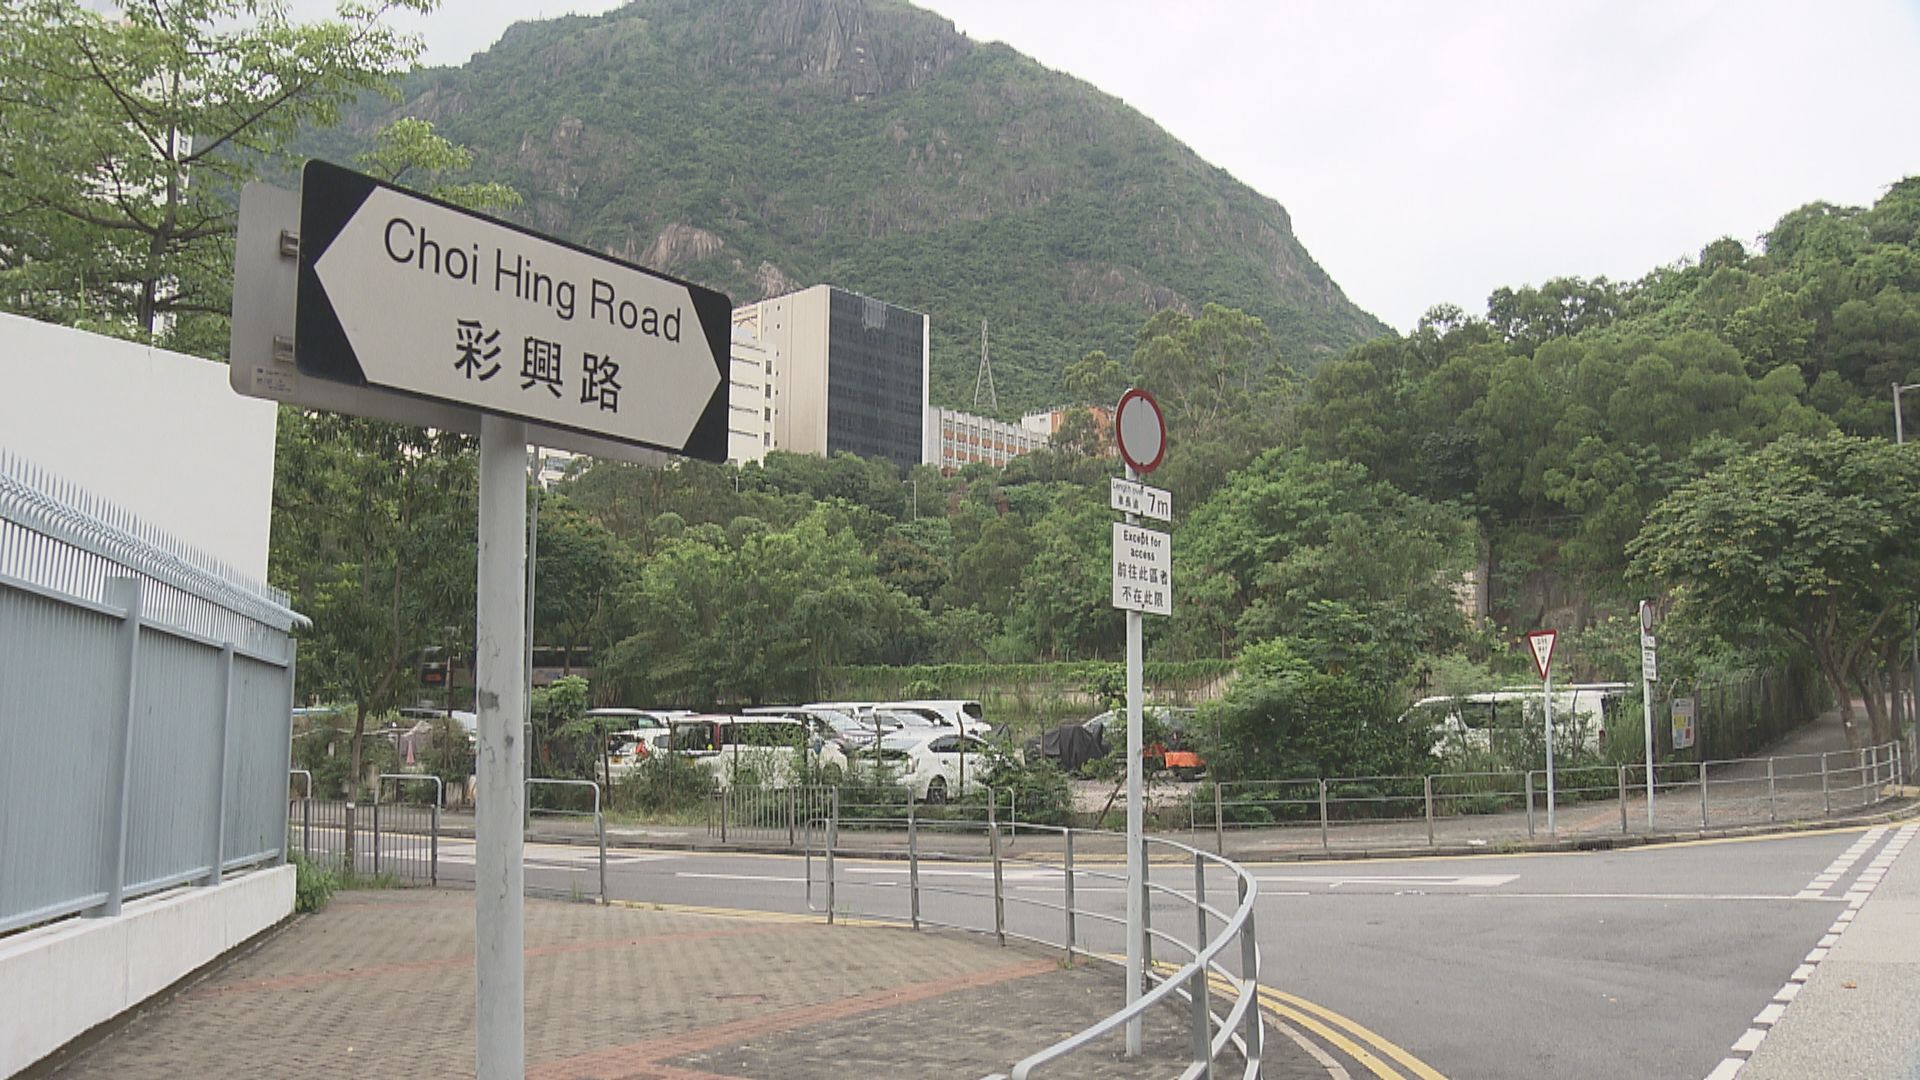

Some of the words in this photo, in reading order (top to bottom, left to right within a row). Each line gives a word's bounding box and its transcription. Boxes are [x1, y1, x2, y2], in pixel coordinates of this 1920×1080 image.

[384, 217, 479, 285] Choi
[495, 248, 577, 321] Hing
[590, 278, 682, 344] Road
[453, 318, 623, 414] 彩興路
[1147, 491, 1168, 516] 7m
[1123, 529, 1149, 546] Except
[1150, 535, 1161, 548] for
[1130, 547, 1155, 561] access
[1117, 560, 1168, 586] 前往此區者
[1122, 585, 1163, 608] 不在此限
